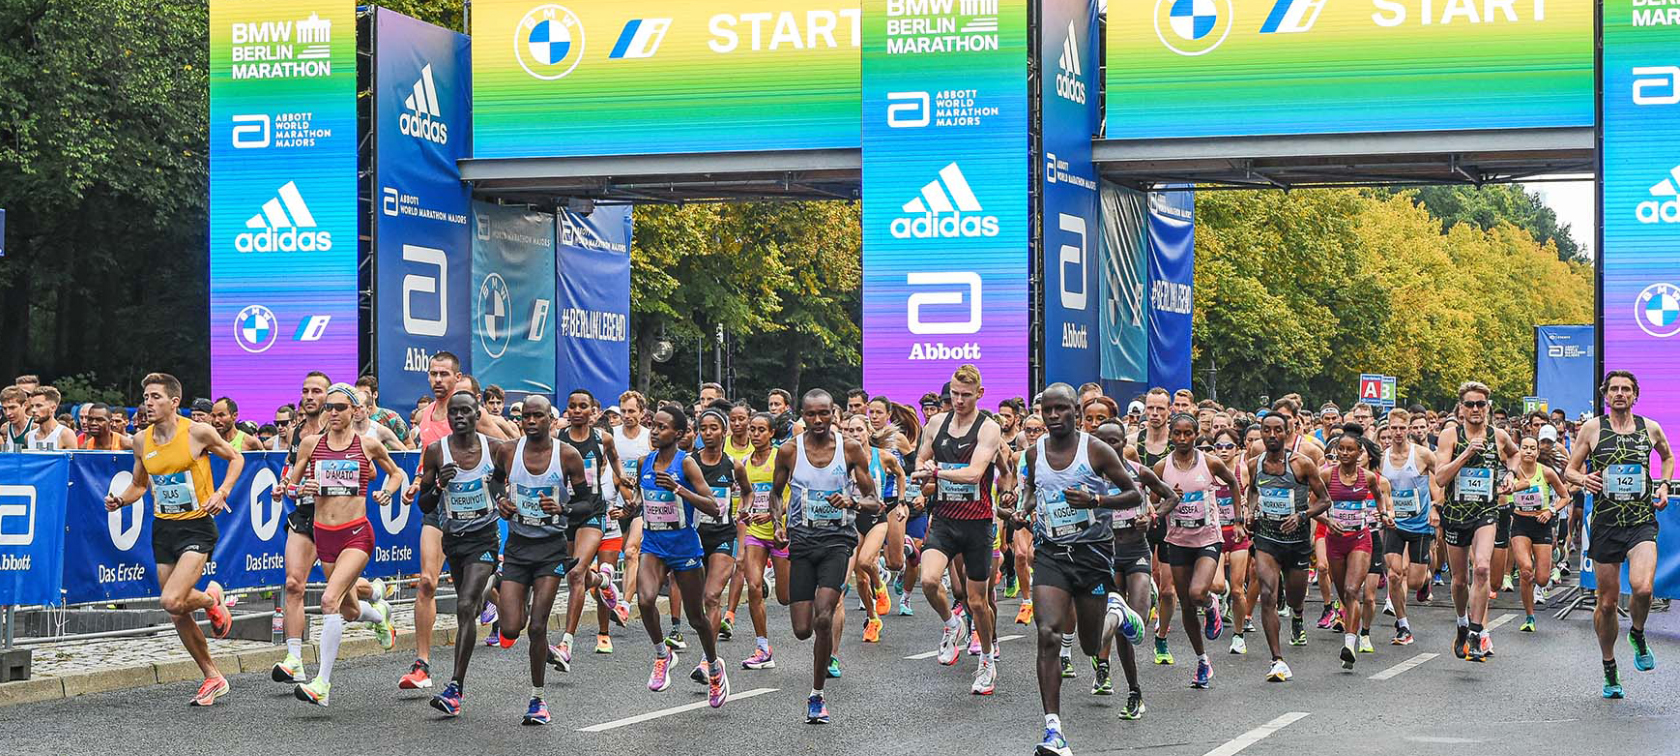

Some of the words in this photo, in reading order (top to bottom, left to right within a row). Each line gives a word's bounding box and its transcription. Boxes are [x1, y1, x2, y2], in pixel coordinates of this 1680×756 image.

[887, 0, 953, 16] BMW
[232, 21, 292, 44] BMW
[707, 9, 861, 53] START
[887, 18, 955, 35] BERLIN
[887, 35, 998, 54] MARATHON
[232, 45, 293, 61] BERLIN
[232, 61, 331, 79] MARATHON
[935, 90, 977, 99] ABBOTT
[1056, 70, 1085, 104] adidas
[935, 99, 974, 108] WORLD
[275, 113, 312, 122] ABBOTT
[935, 107, 999, 118] MARATHON
[275, 122, 309, 130] WORLD
[399, 111, 447, 145] adidas
[935, 117, 980, 126] MAJORS
[275, 129, 332, 139] MARATHON
[275, 138, 315, 147] MAJORS
[400, 205, 418, 216] WORLD
[418, 209, 448, 221] MARATHON
[448, 213, 467, 224] MAJORS
[890, 211, 1000, 239] adidas
[235, 227, 332, 252] adidas
[1062, 322, 1087, 349] Abbott
[908, 342, 982, 360] Abbott
[1364, 382, 1378, 398] A
[1467, 479, 1481, 487] 141
[1617, 477, 1634, 485] 142
[162, 489, 180, 499] SILAS
[450, 494, 483, 506] CHERUIYOT
[521, 500, 541, 512] KIPRO
[245, 554, 262, 571] Das
[262, 552, 284, 570] Erste
[375, 546, 391, 562] Das
[391, 545, 412, 561] Erste
[0, 554, 31, 570] bbott
[98, 564, 116, 584] Das
[118, 562, 145, 582] Erste
